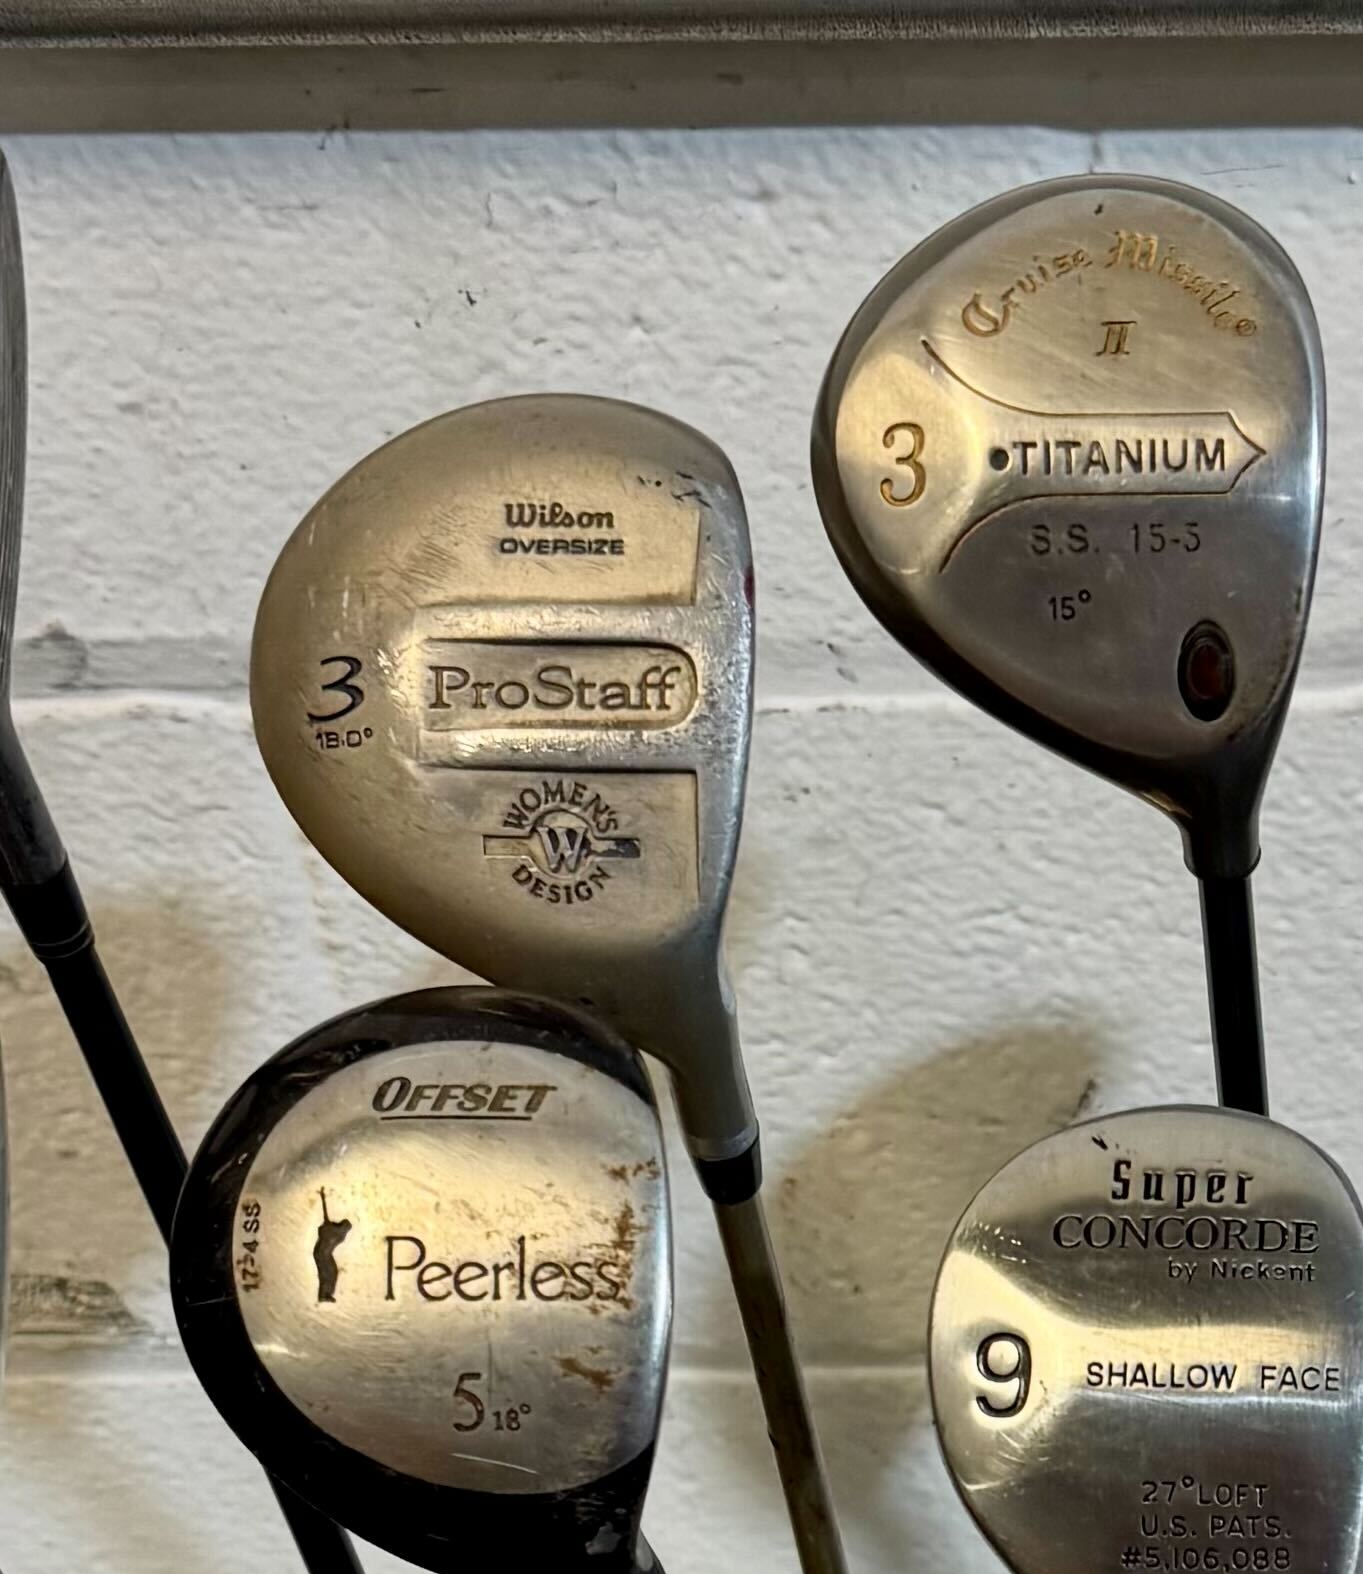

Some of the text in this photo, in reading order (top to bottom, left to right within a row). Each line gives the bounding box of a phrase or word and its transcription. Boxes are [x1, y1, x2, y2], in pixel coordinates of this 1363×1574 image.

[961, 249, 1094, 337] Cruise
[879, 421, 926, 507] 3
[1012, 438, 1227, 473] TITANIUM
[504, 502, 615, 529] Wilson
[500, 538, 625, 556] OVERSIZE
[1031, 523, 1101, 556] S.S.
[1048, 589, 1092, 621] 15°
[307, 655, 365, 724] 3
[428, 664, 682, 712] ProStaff
[502, 778, 619, 833] WOMEN'S
[511, 864, 613, 905] DESIGN
[371, 1075, 557, 1113] OFFSET
[1111, 1159, 1254, 1210] Super
[242, 1201, 261, 1234] SS
[1053, 1214, 1320, 1253] CONCORDE
[385, 1235, 621, 1302] Peerless
[1168, 1257, 1316, 1283] by Nickent
[976, 1332, 1032, 1419] 9
[1086, 1361, 1341, 1391] SHALLOW FACE
[452, 1372, 532, 1432] 5 18°
[1140, 1514, 1292, 1538] U.S. PATS.
[1121, 1546, 1291, 1573] #5,106,088
